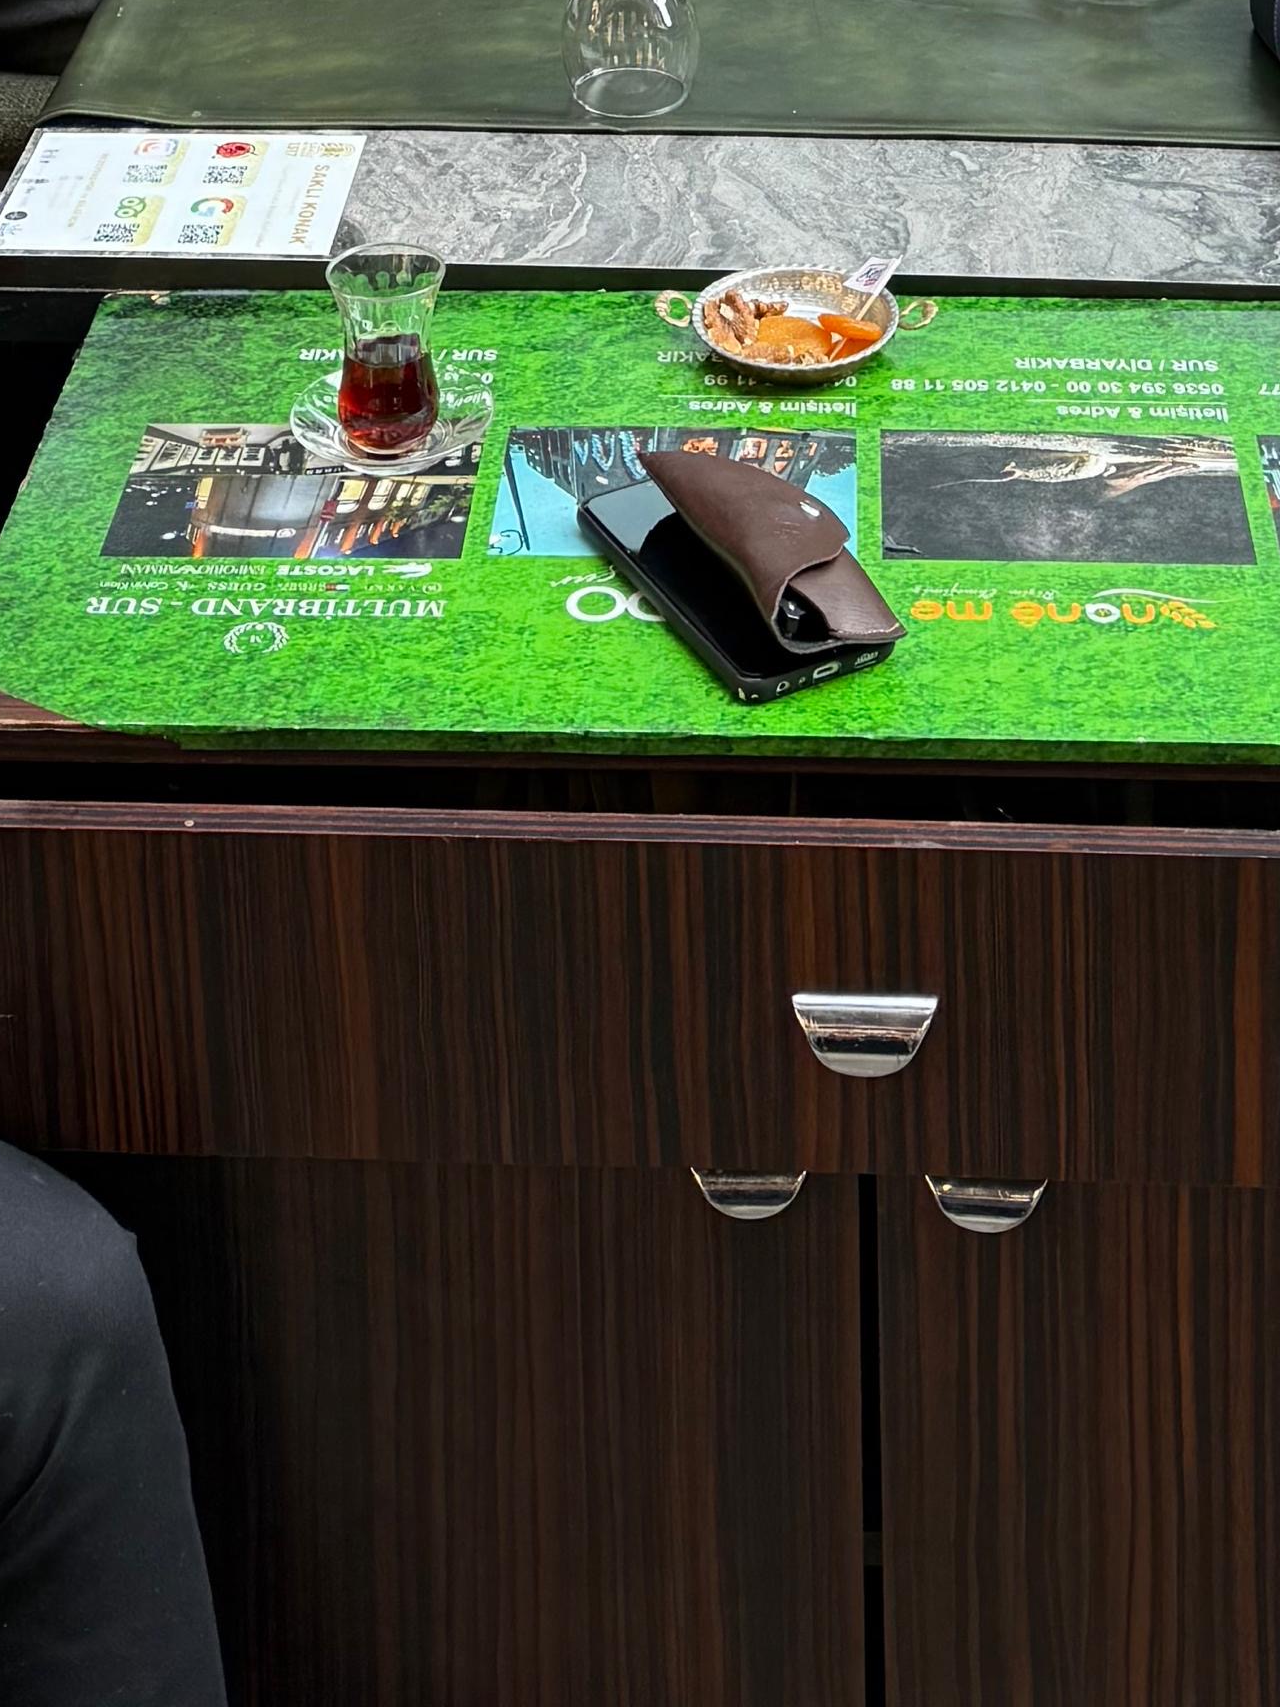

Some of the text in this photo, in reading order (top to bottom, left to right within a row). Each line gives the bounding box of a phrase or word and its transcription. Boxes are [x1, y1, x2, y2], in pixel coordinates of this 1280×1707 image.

[306, 164, 330, 198] SAKLI
[452, 348, 498, 362] SUR
[1170, 358, 1219, 373] SUR
[890, 378, 916, 391] 88
[923, 378, 943, 391] 11
[950, 379, 989, 392] 505
[994, 380, 1048, 393] 0412
[1065, 381, 1091, 394] 00
[1097, 382, 1123, 395] 30
[1128, 382, 1167, 396] 394
[1172, 383, 1225, 397] 0536
[687, 399, 753, 414] Adres
[757, 400, 772, 414] &
[1055, 404, 1120, 419] Adres
[1127, 404, 1144, 419] &
[275, 564, 376, 576] LACOSTE
[85, 596, 165, 616] SUR
[191, 597, 449, 621] MULTİBRAND
[909, 600, 994, 622] me
